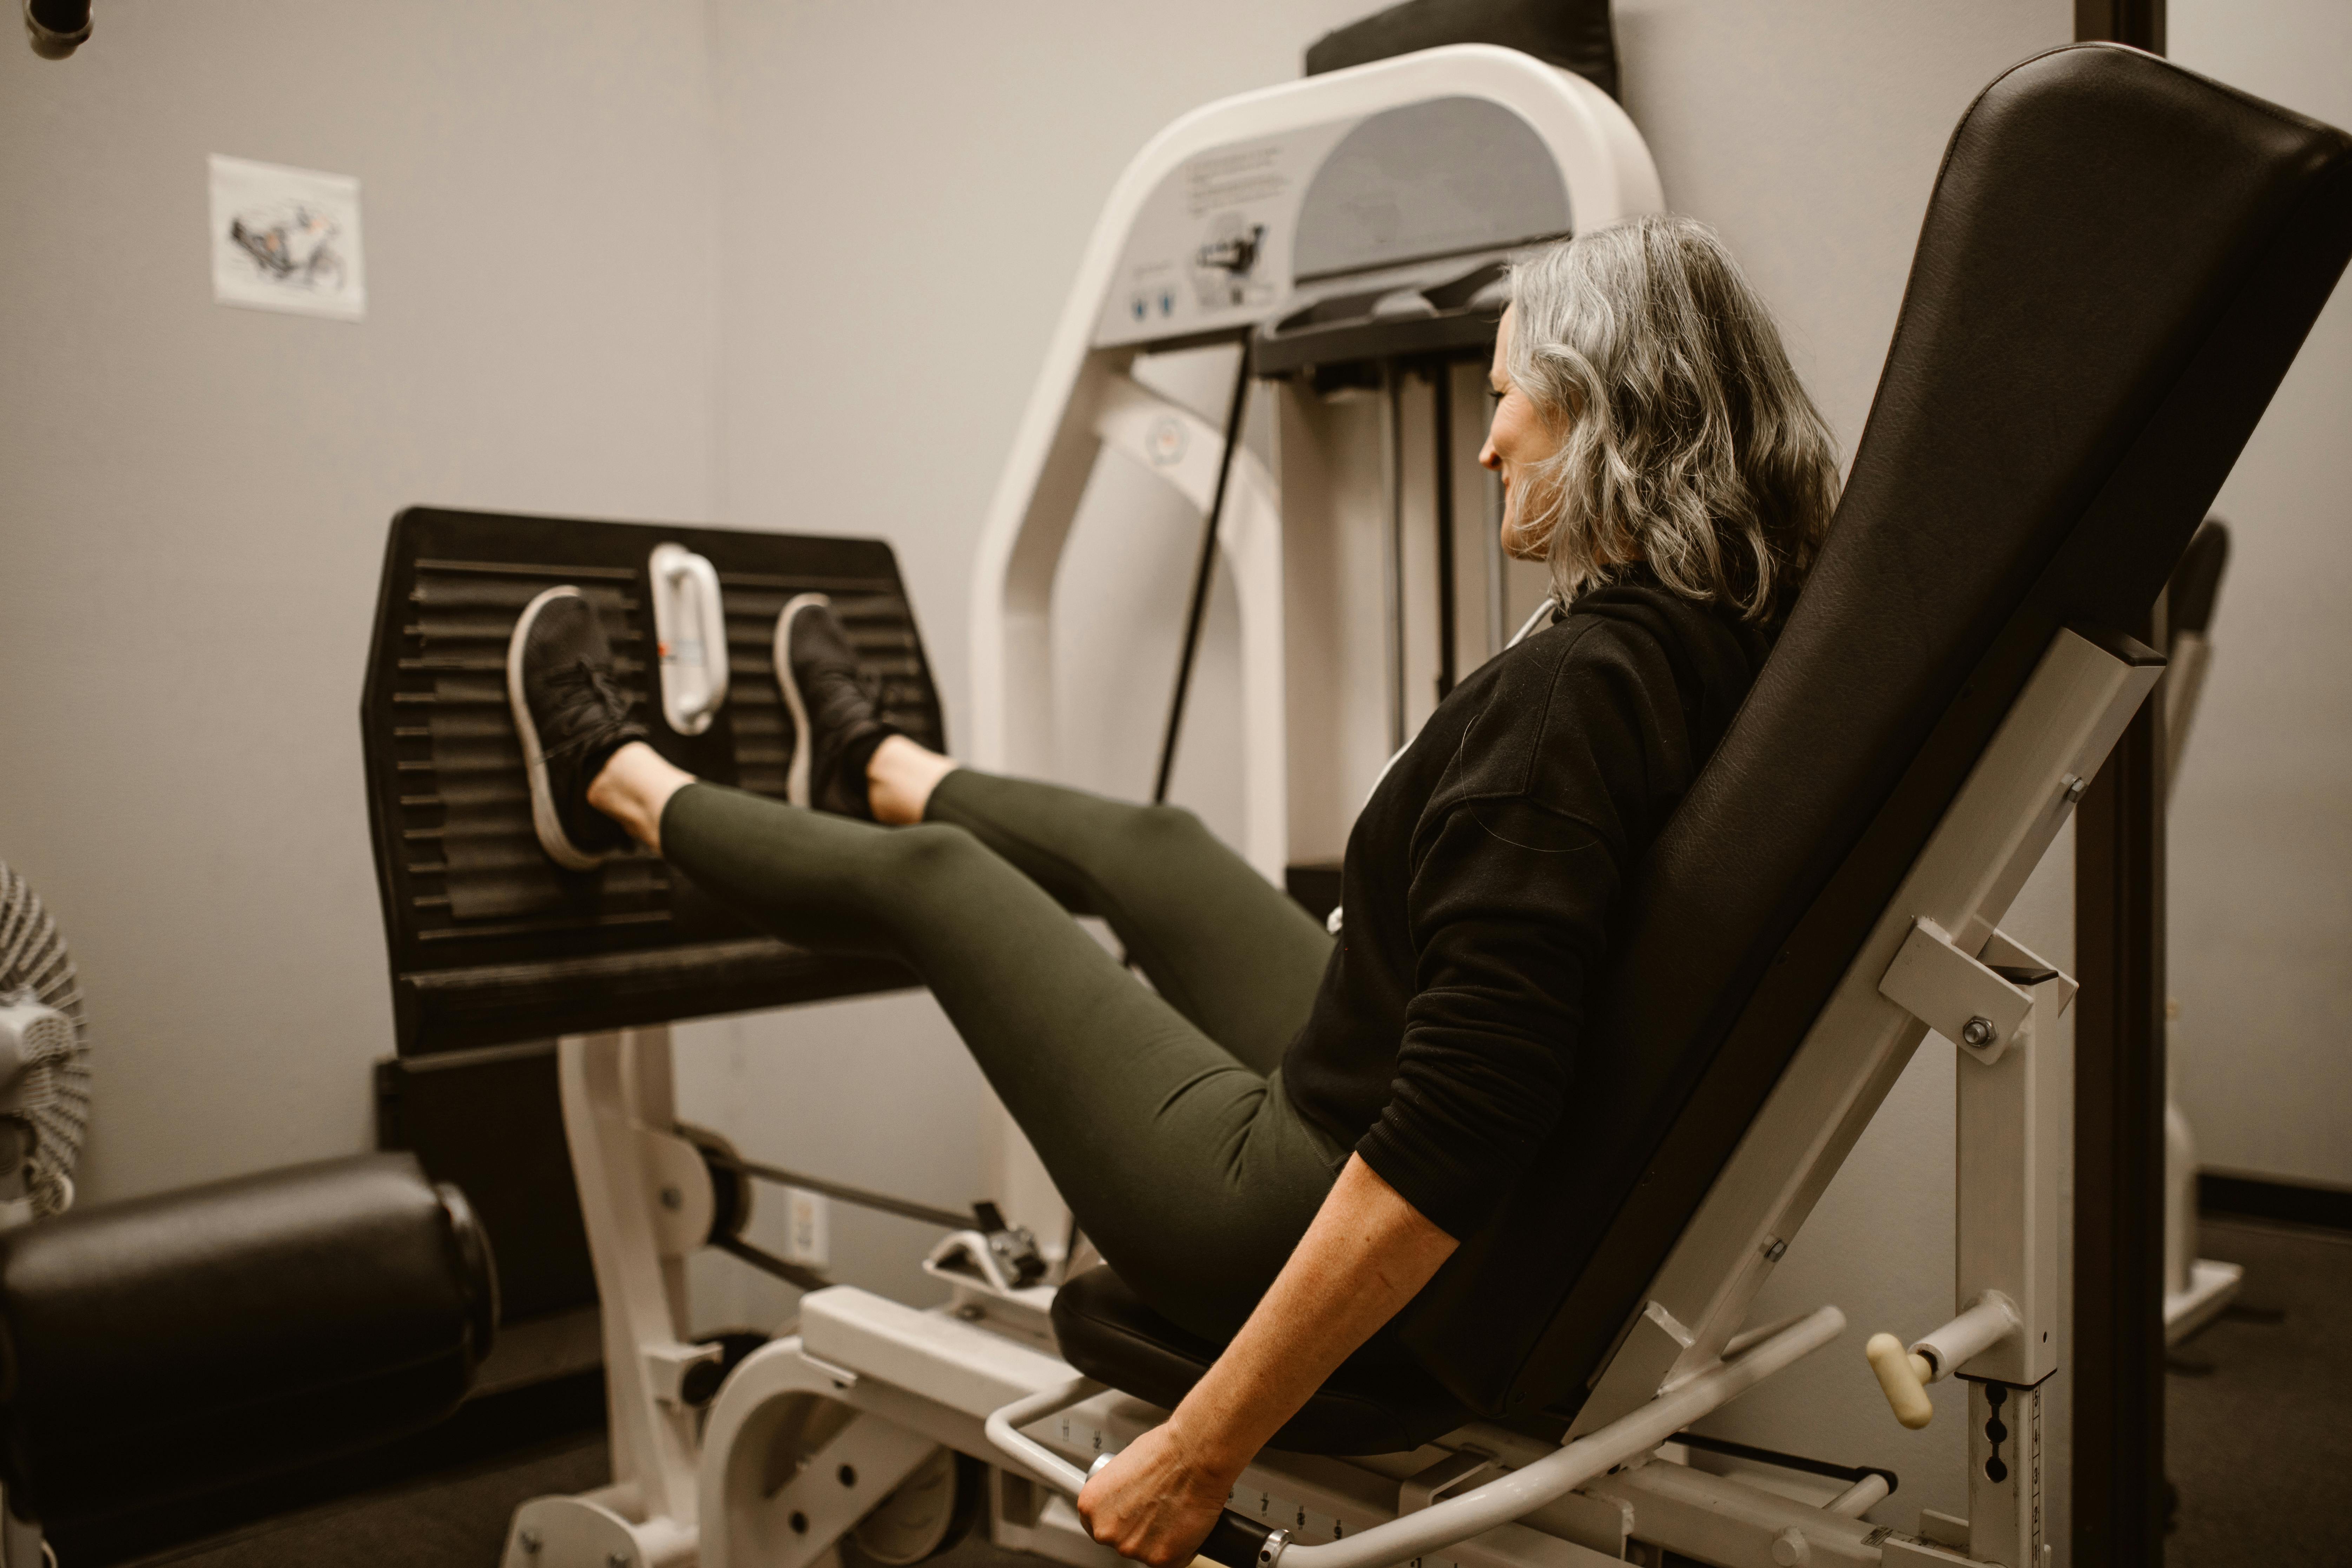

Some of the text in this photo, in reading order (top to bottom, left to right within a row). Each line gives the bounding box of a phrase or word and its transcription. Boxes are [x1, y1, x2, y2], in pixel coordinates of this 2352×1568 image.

[2034, 1390, 2038, 1407] 5
[2034, 1429, 2038, 1445] 4
[2034, 1467, 2038, 1484] 3
[1260, 1498, 1269, 1511] 7
[1297, 1512, 1305, 1526] 8
[1334, 1526, 1342, 1539] 9
[2034, 1506, 2038, 1524] 2
